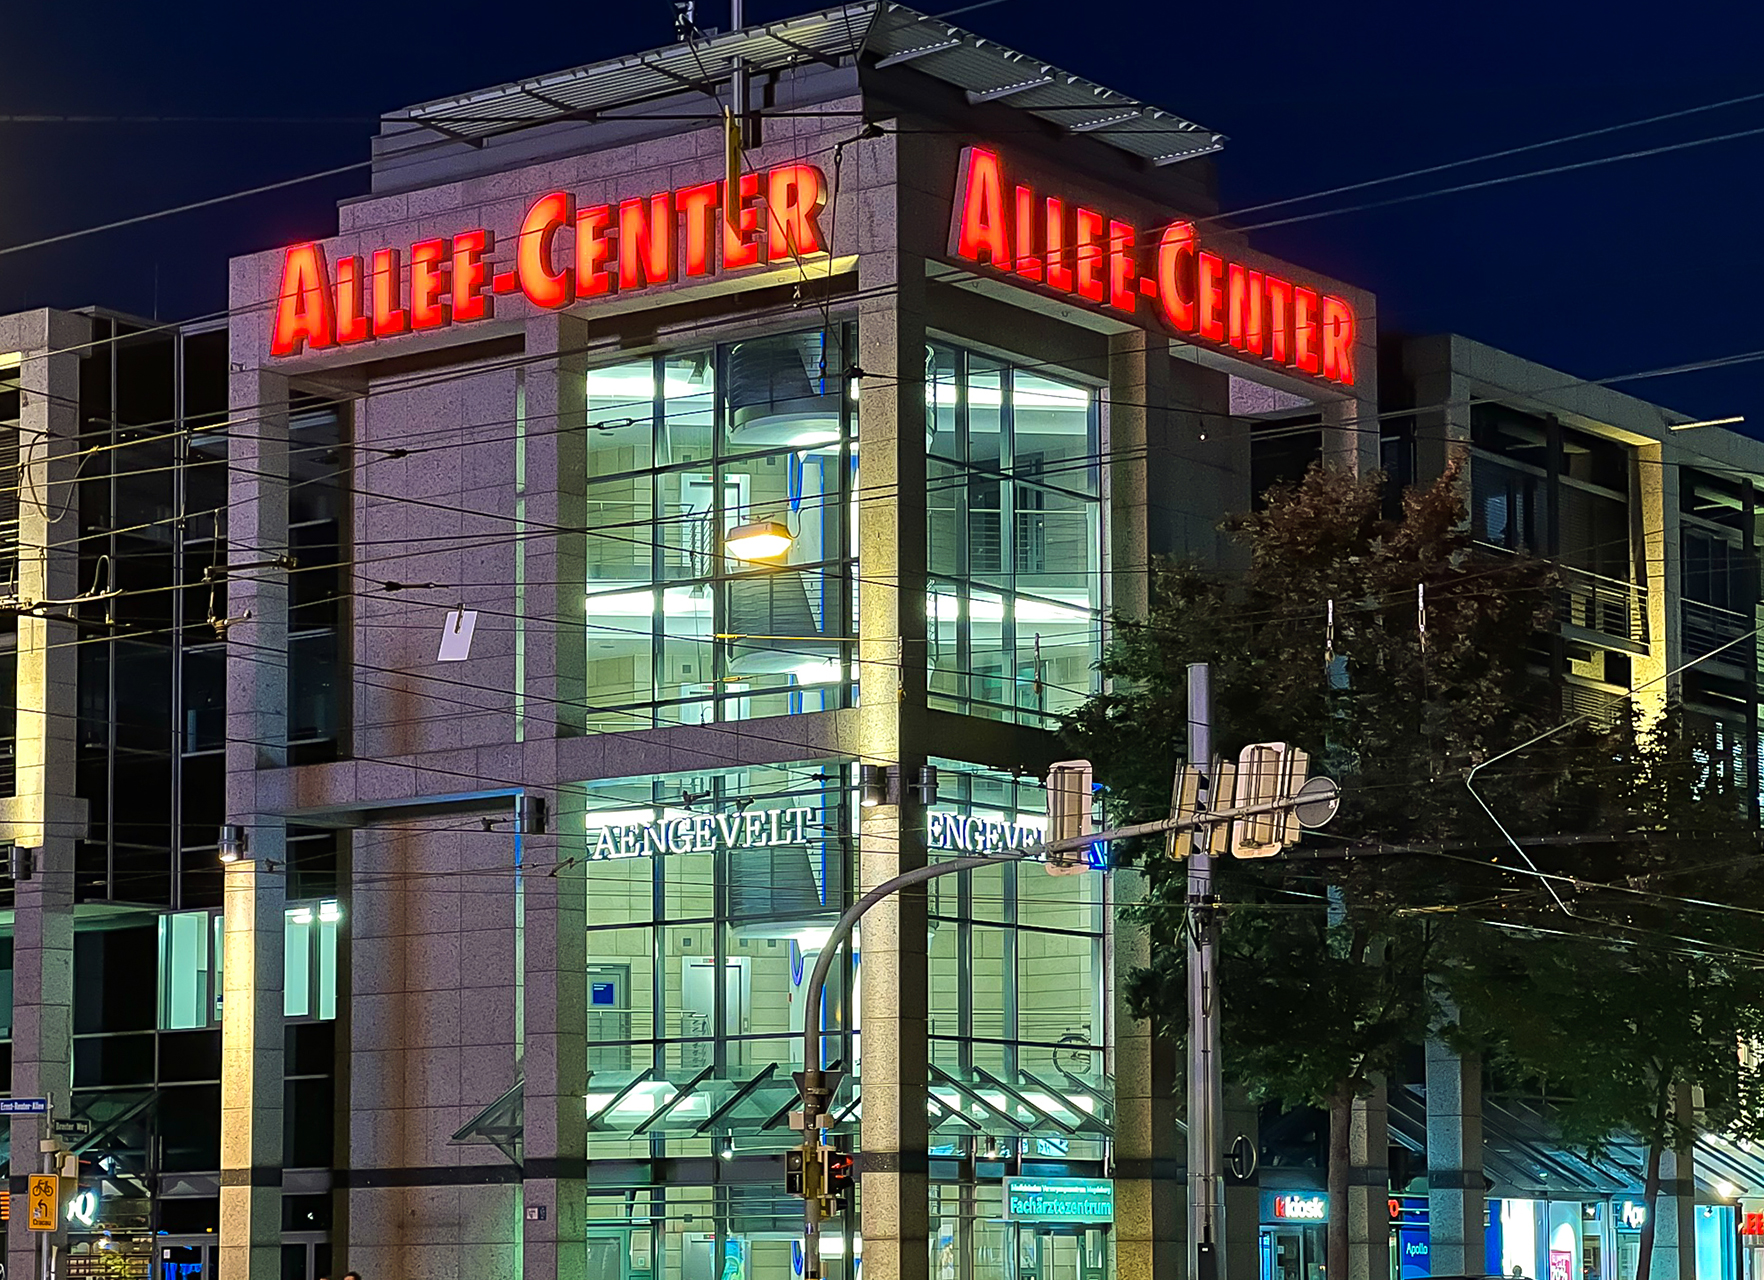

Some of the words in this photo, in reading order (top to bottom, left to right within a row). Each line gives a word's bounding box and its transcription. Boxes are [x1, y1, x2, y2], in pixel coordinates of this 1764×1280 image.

[270, 164, 828, 357] ALLEE-CENTER
[947, 145, 1356, 386] ALLEE-CENTER
[592, 807, 817, 861] AENGEVELT
[1010, 1196, 1112, 1215] Fachärztezentrum
[1405, 1242, 1428, 1258] Apollo
